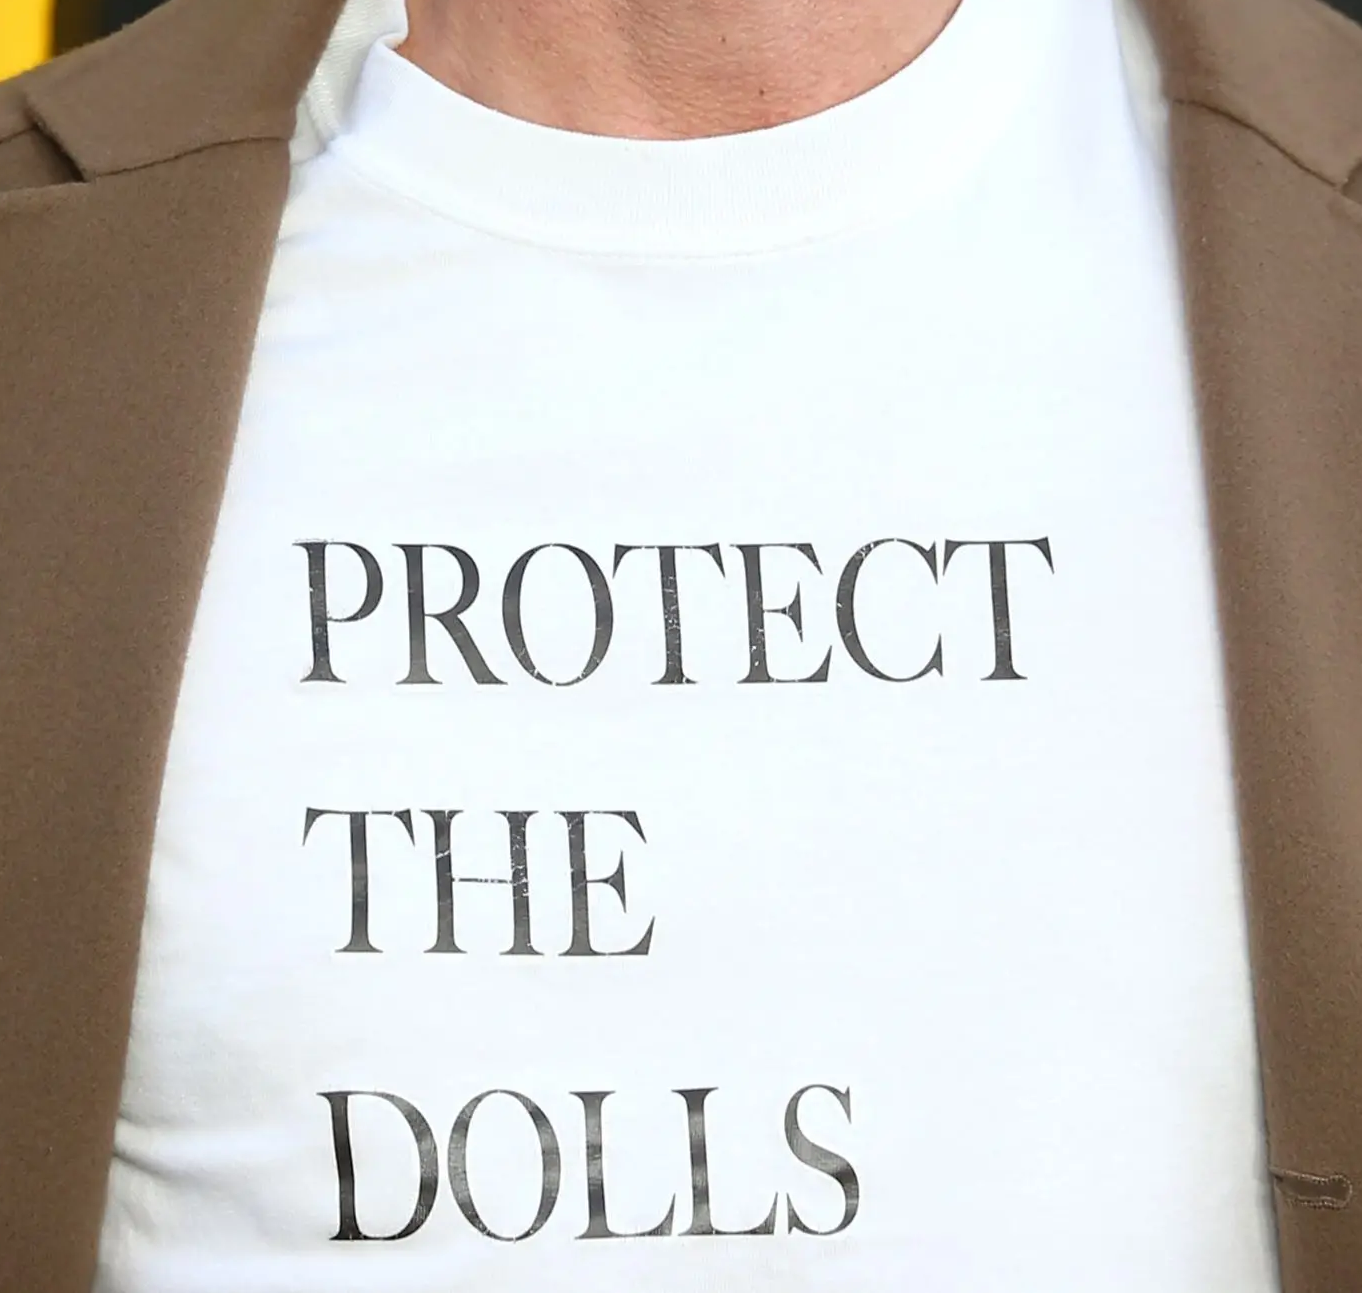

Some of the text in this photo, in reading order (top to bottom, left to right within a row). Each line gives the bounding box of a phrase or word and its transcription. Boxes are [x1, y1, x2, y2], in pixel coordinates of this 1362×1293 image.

[293, 537, 1055, 687] PROTECT
[303, 807, 655, 956] THE
[316, 1084, 860, 1241] DOLLS
